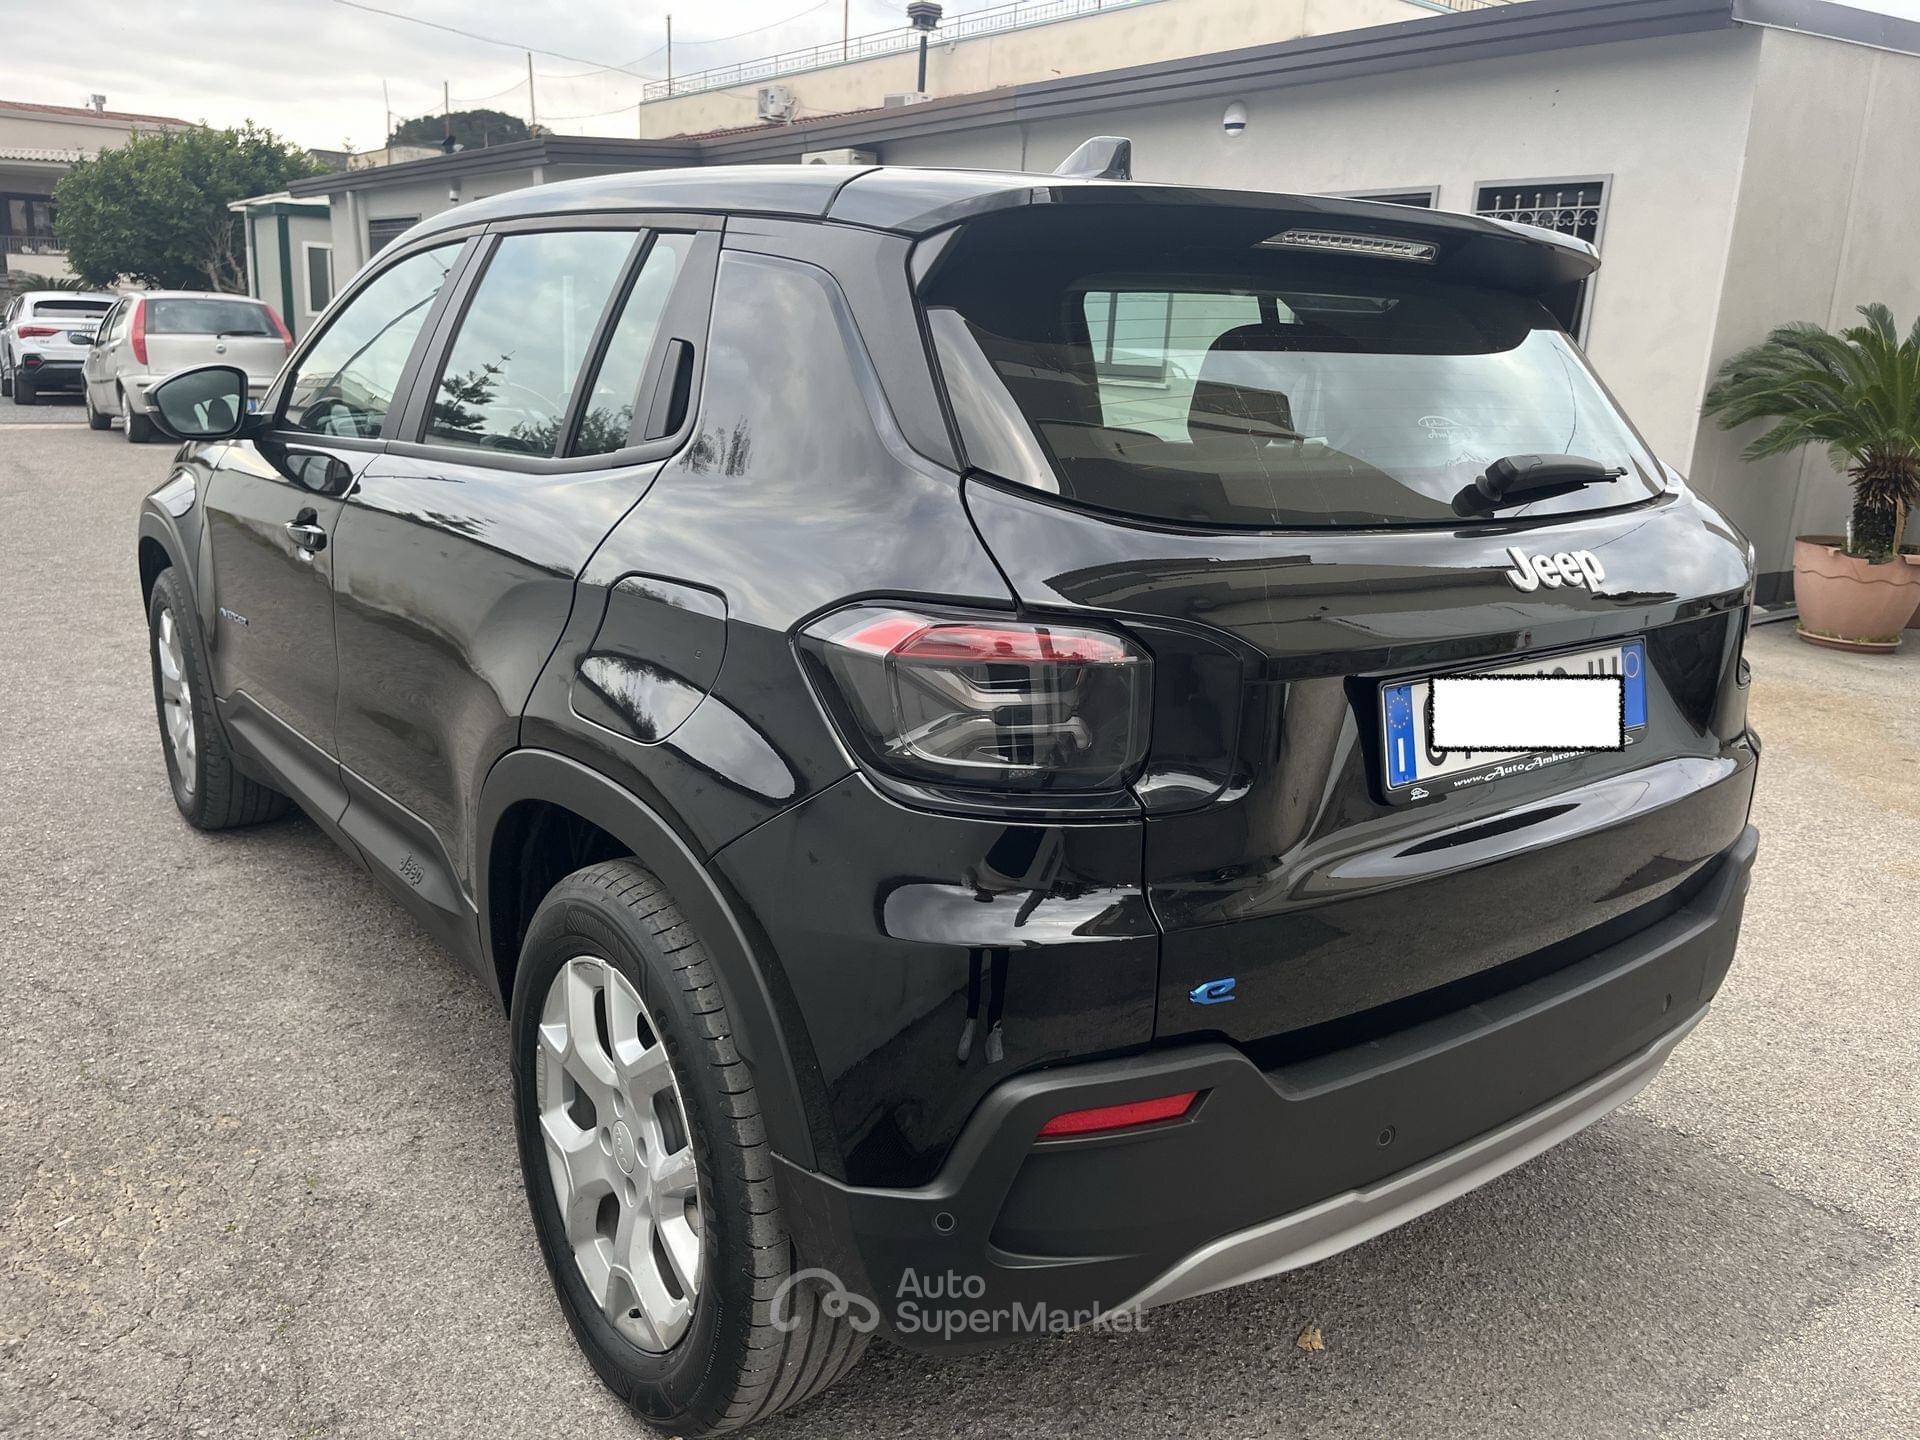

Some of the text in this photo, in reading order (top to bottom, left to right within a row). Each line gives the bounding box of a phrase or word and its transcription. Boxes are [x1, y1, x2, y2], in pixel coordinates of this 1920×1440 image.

[1505, 546, 1605, 593] Jeep
[1397, 737, 1406, 773] I
[1453, 751, 1585, 787] www.AutoAmbrosi
[399, 854, 424, 887] Jeep
